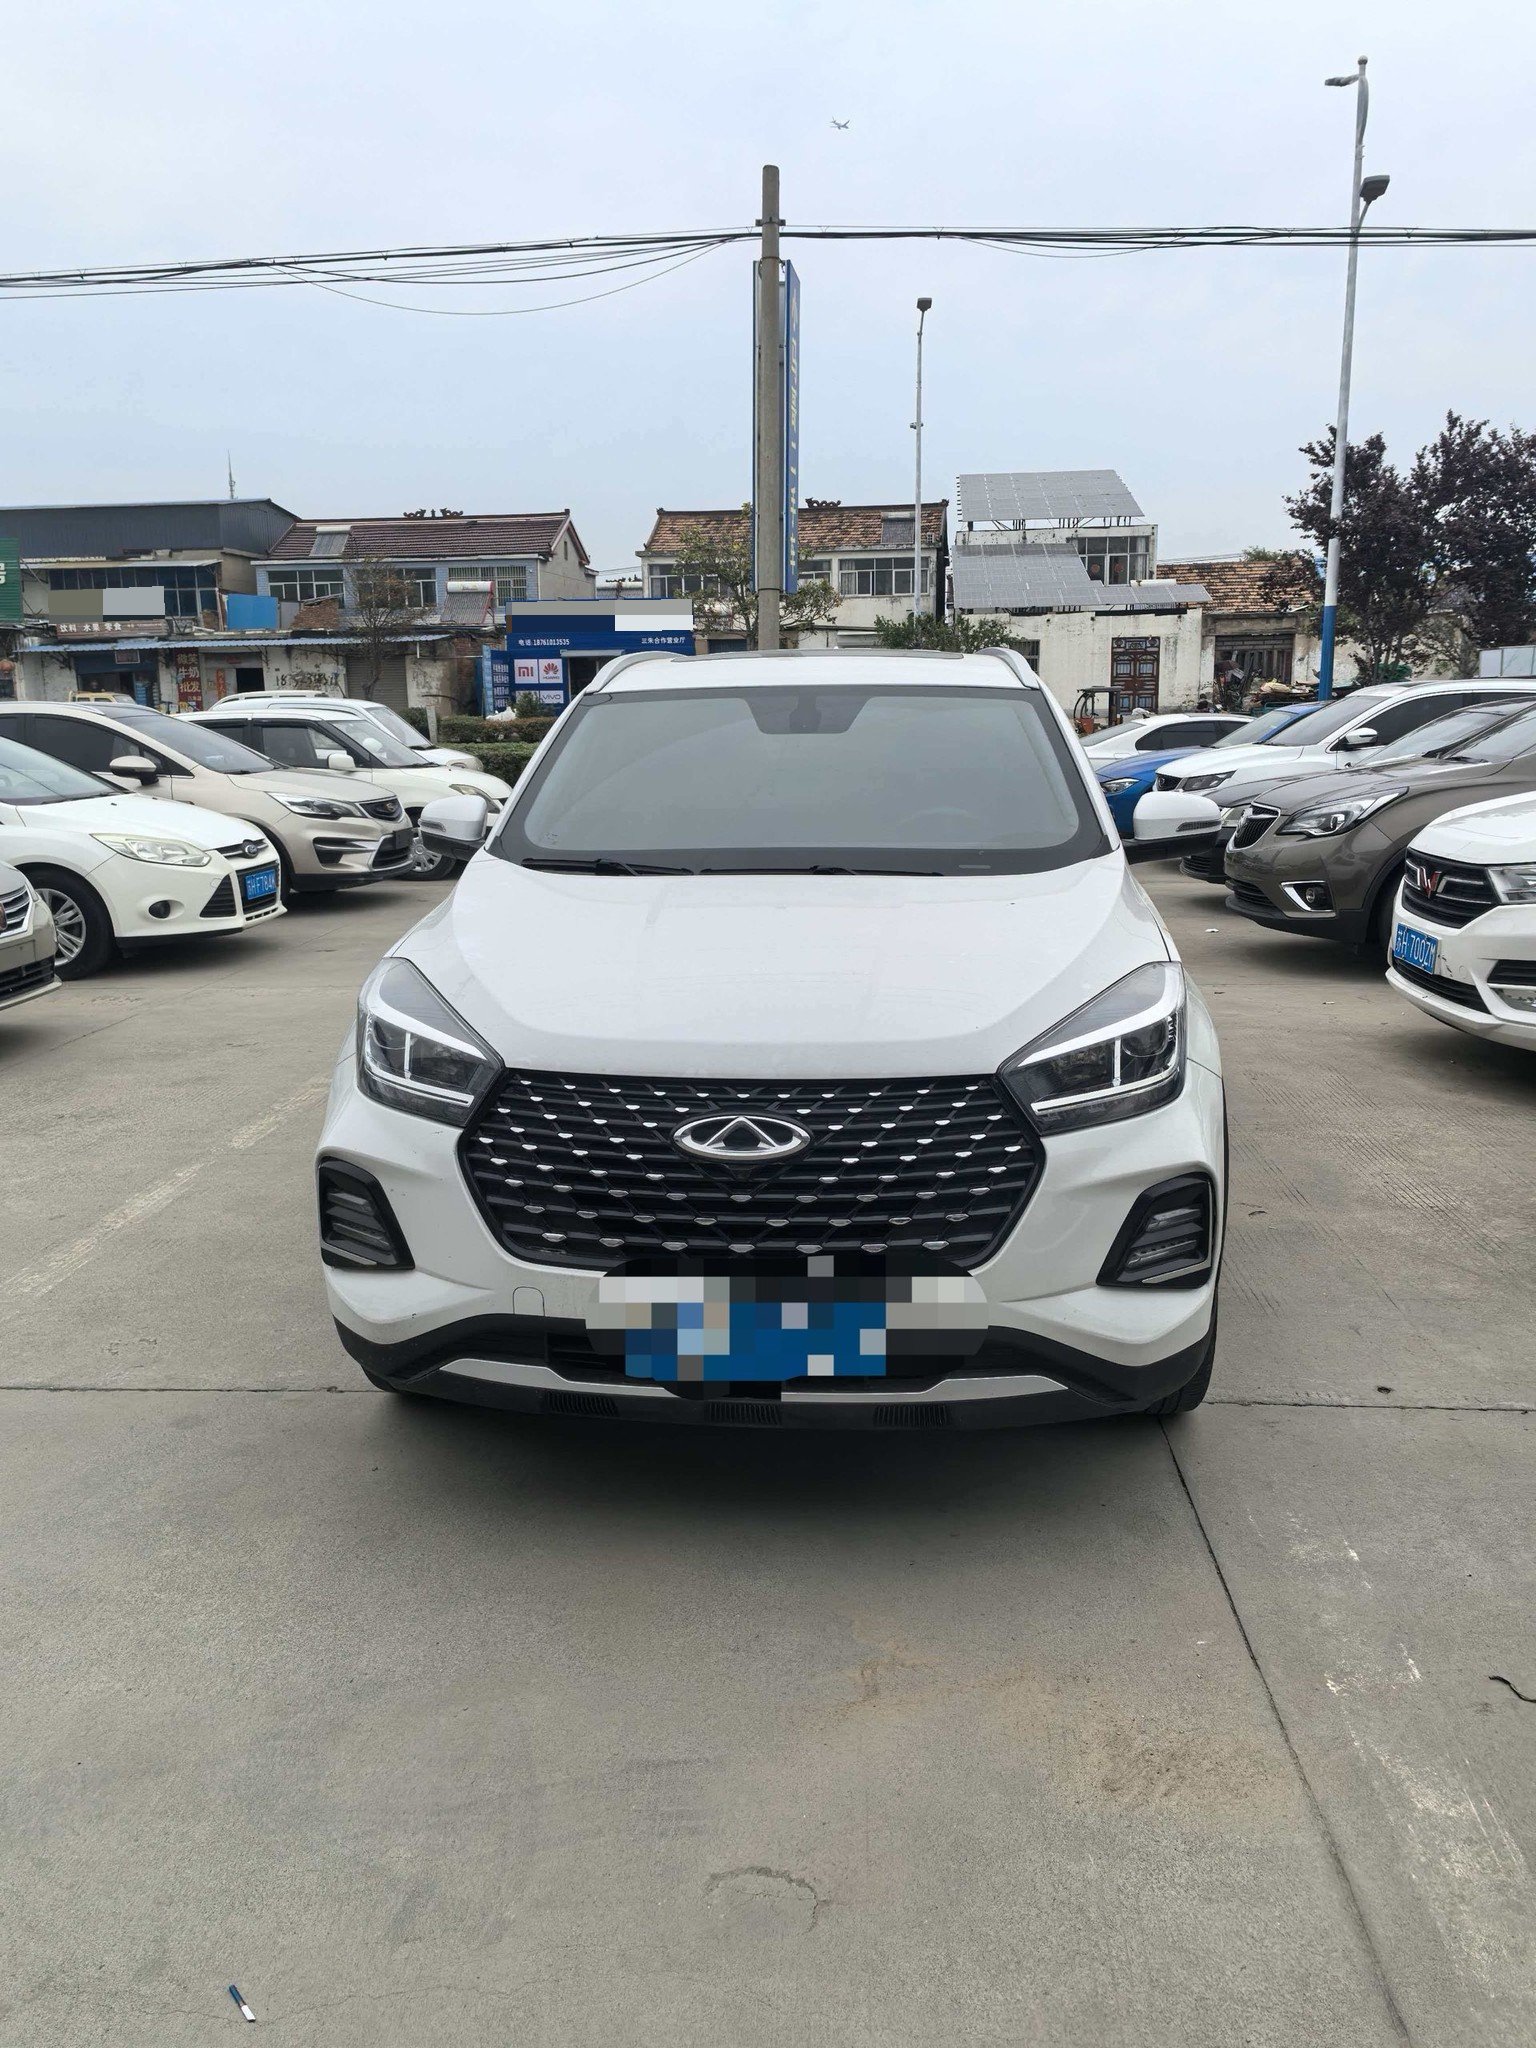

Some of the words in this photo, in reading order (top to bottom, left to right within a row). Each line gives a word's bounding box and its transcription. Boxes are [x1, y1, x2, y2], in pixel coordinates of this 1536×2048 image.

[59, 624, 77, 632] 饮料
[83, 623, 101, 632] 水果
[104, 622, 122, 631] 零食
[179, 680, 201, 692] 批发
